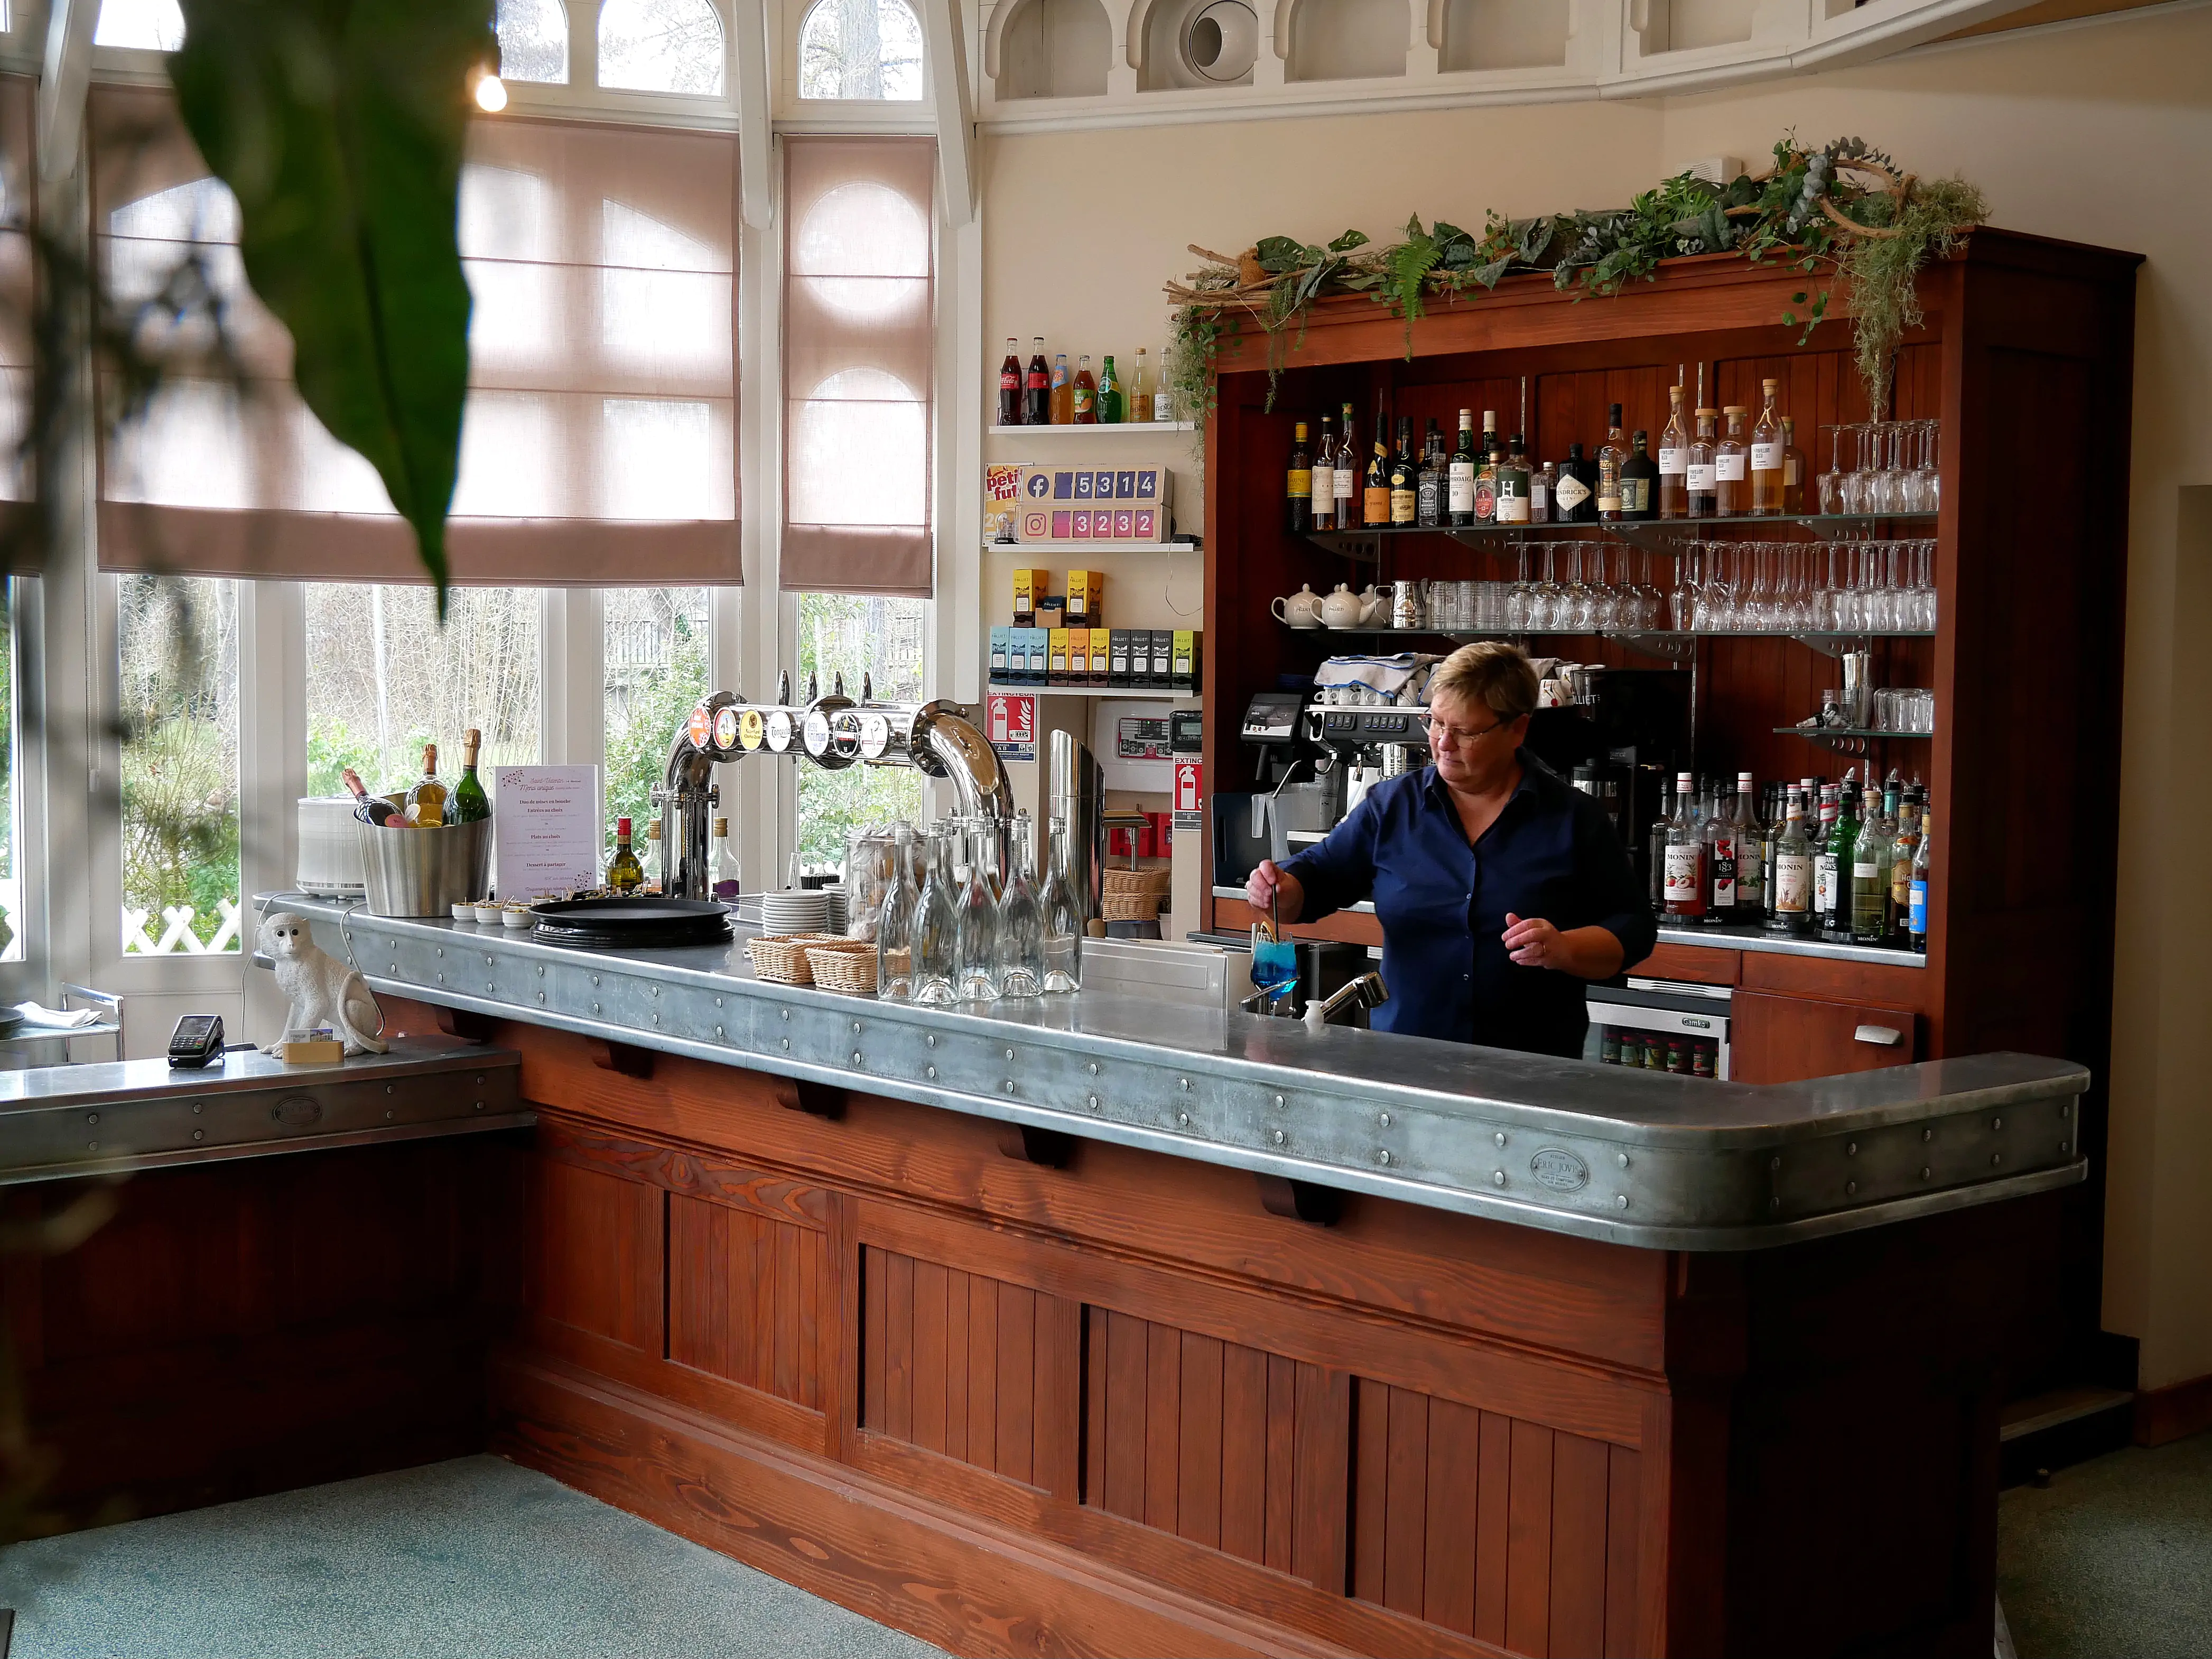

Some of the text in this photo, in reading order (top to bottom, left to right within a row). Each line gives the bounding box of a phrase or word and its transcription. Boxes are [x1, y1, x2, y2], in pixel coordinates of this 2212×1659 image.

[1501, 481, 1514, 498] H
[1684, 1018, 1706, 1028] Gamko
[1537, 1158, 1554, 1169] ERIC
